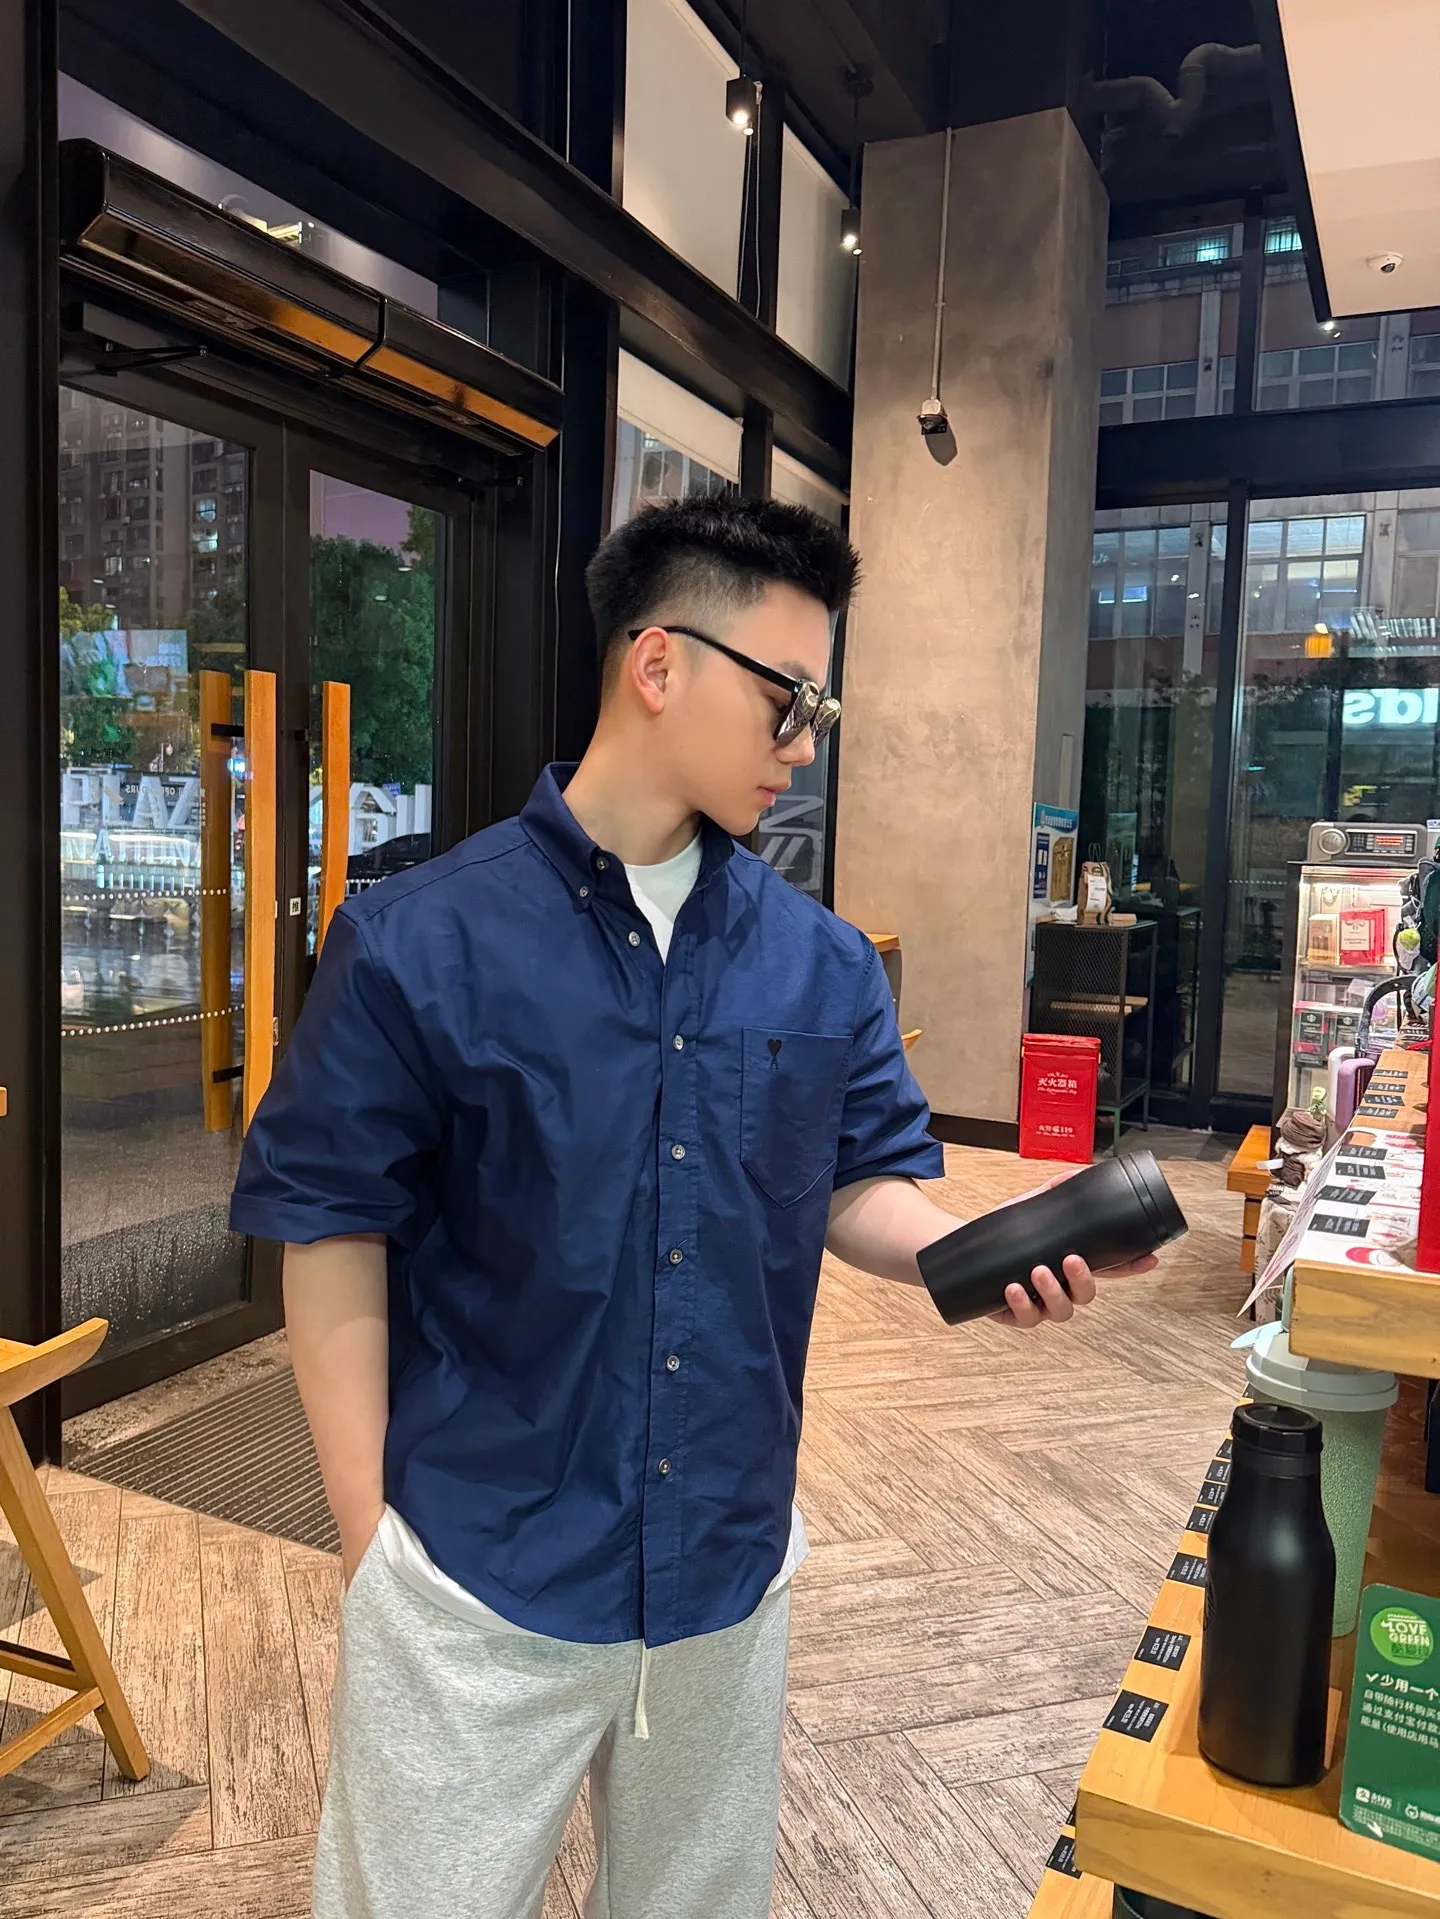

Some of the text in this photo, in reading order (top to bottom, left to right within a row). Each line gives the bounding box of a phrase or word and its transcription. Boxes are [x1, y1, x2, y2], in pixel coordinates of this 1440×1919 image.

[62, 773, 202, 829] PLAZ
[1037, 1077, 1077, 1088] 灭火器箱
[1388, 1622, 1428, 1635] LOVE
[1388, 1632, 1430, 1647] GREEN
[1380, 1674, 1439, 1702] 少用一个
